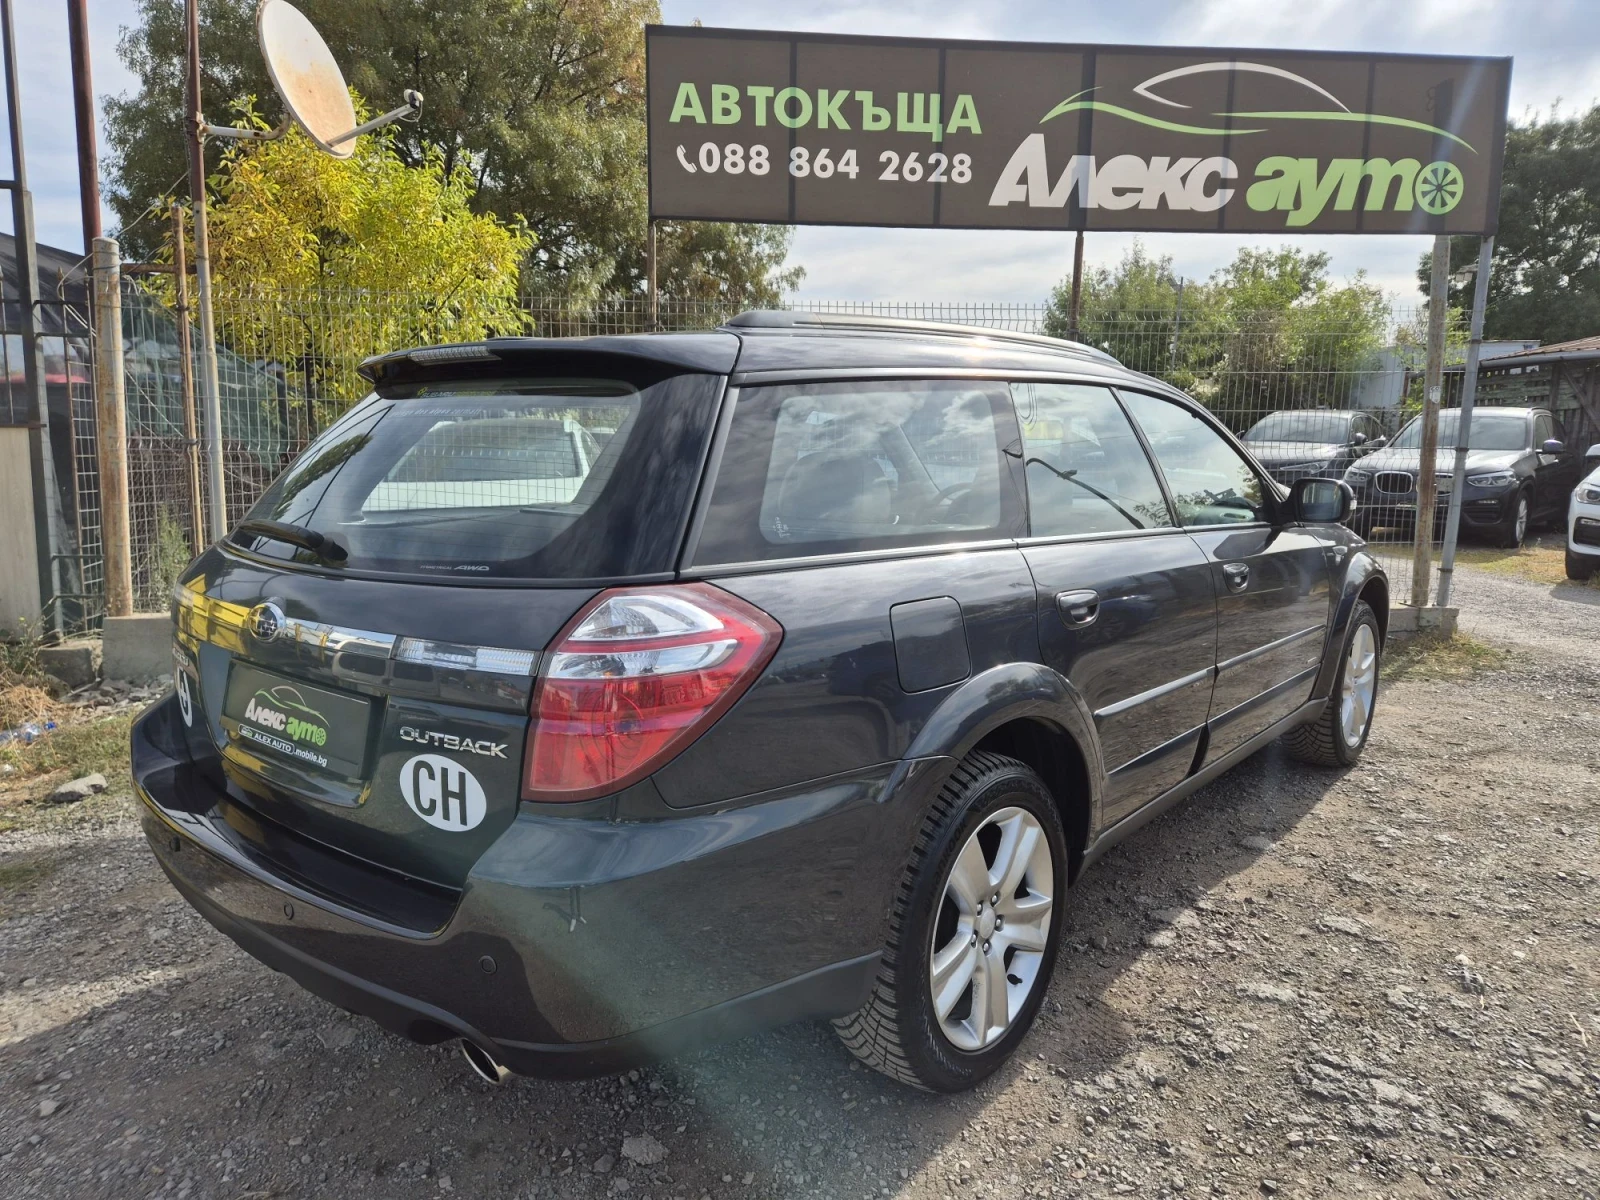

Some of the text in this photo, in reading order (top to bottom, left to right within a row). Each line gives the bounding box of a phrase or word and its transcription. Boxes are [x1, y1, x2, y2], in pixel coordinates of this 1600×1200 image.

[669, 82, 983, 142] АВТОКЪЩА
[699, 142, 973, 184] 088 864 2628
[988, 133, 1239, 211] Алекс
[245, 698, 287, 731] Алекс
[254, 733, 272, 746] ALEX
[271, 739, 292, 752] AUTO
[399, 726, 509, 759] OUTBACK
[412, 760, 468, 827] CH
